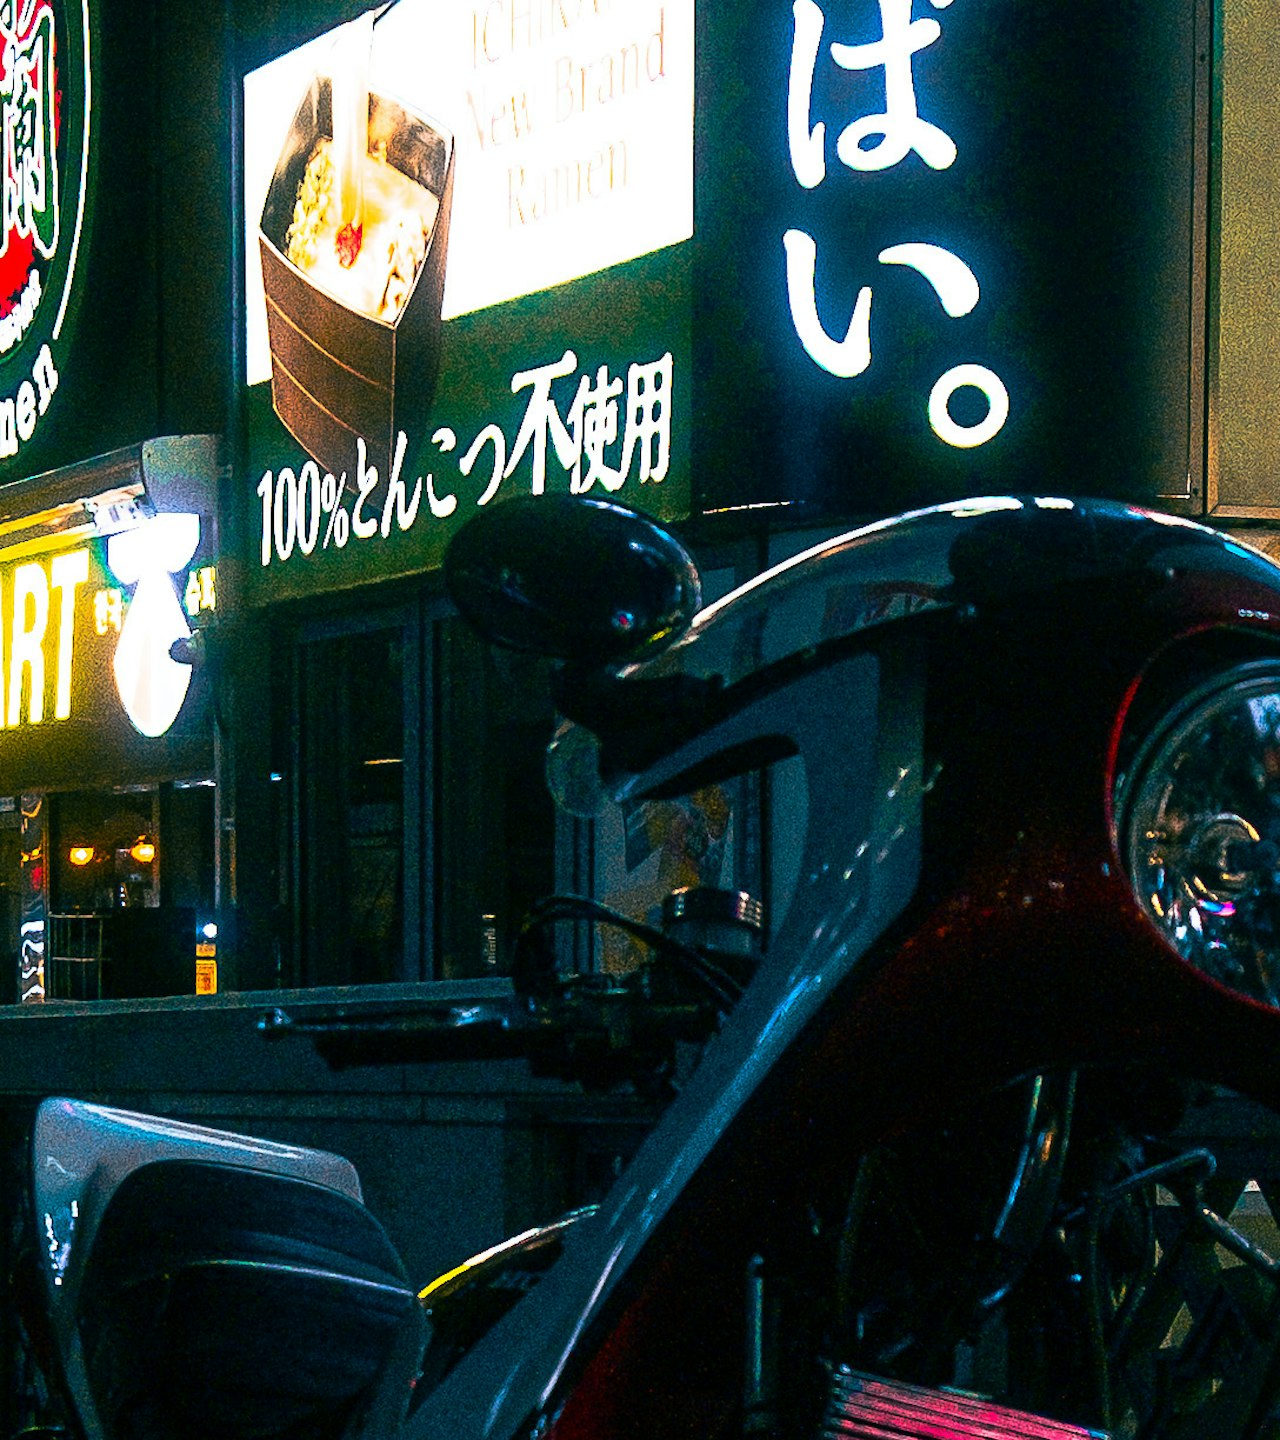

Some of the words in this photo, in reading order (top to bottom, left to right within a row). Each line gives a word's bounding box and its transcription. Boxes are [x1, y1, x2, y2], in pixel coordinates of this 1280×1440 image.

[256, 349, 675, 566] 100%とんこつ不使用
